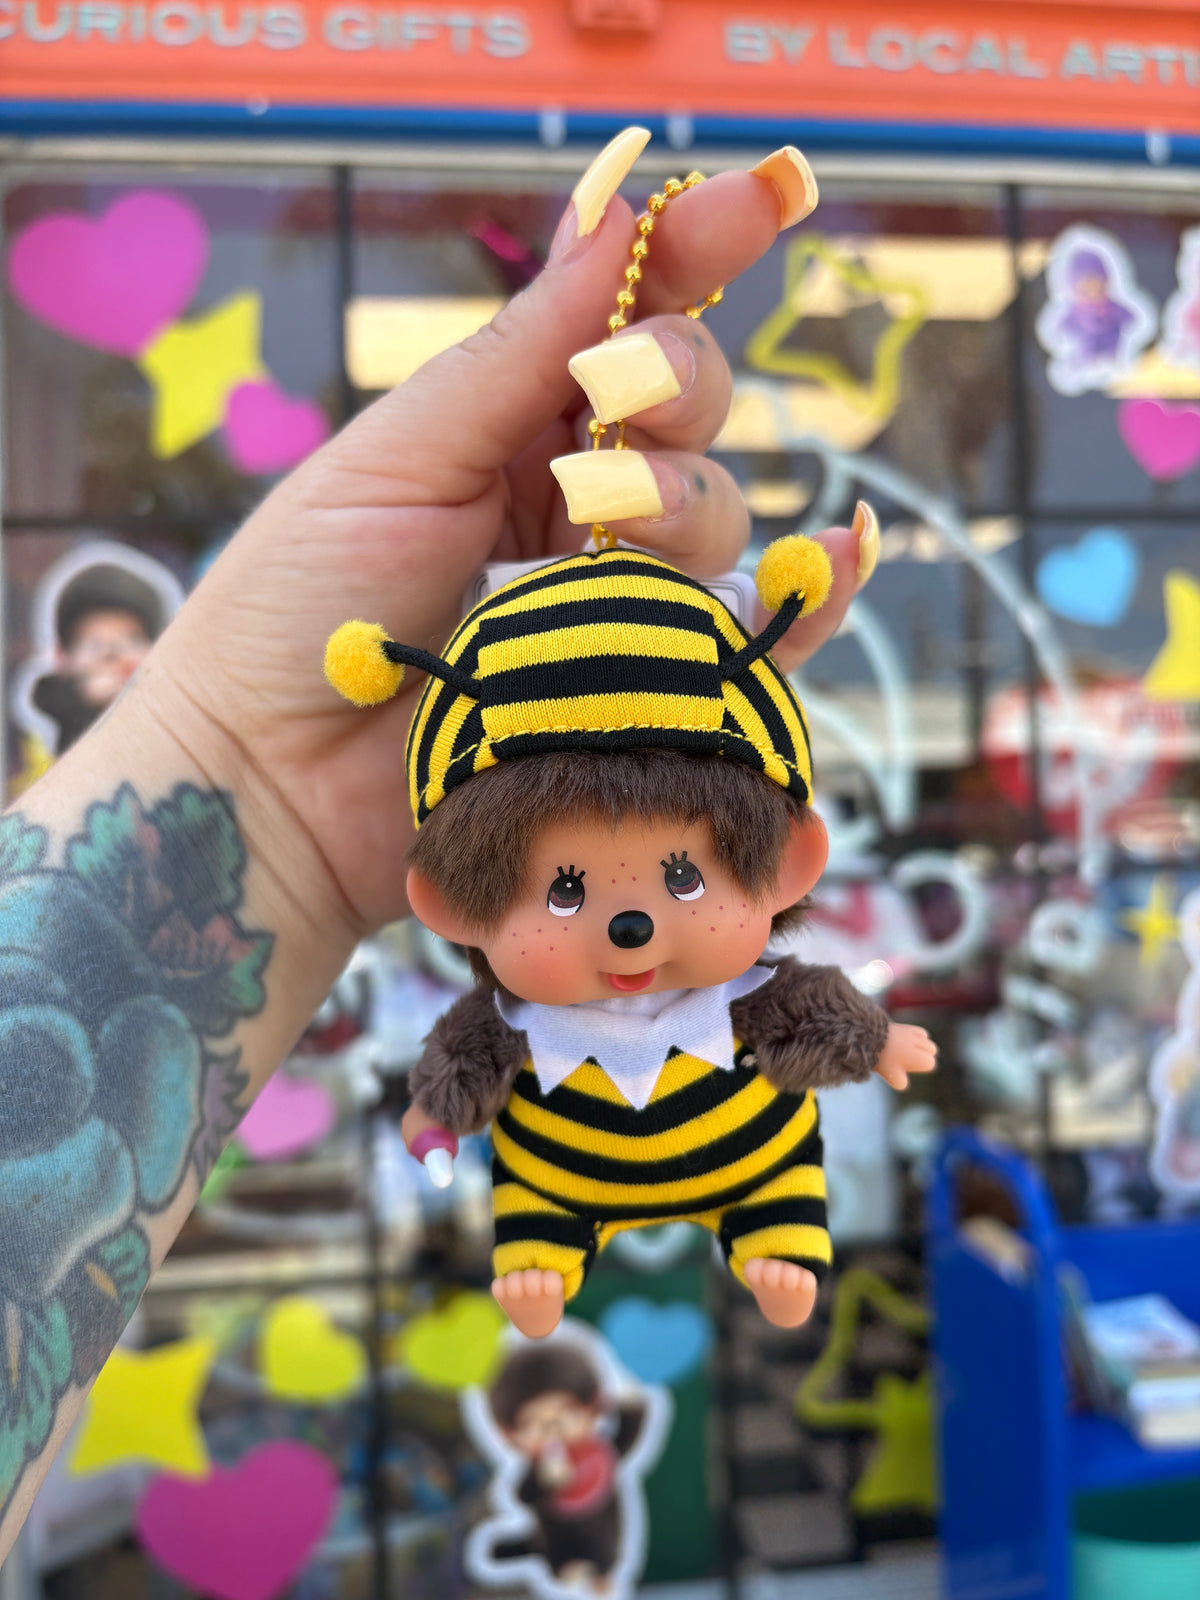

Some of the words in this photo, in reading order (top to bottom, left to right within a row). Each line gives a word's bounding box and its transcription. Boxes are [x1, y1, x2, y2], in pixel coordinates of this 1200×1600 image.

[323, 9, 531, 58] GIFTS
[724, 20, 814, 64] BY
[828, 26, 1044, 79] LOCAL
